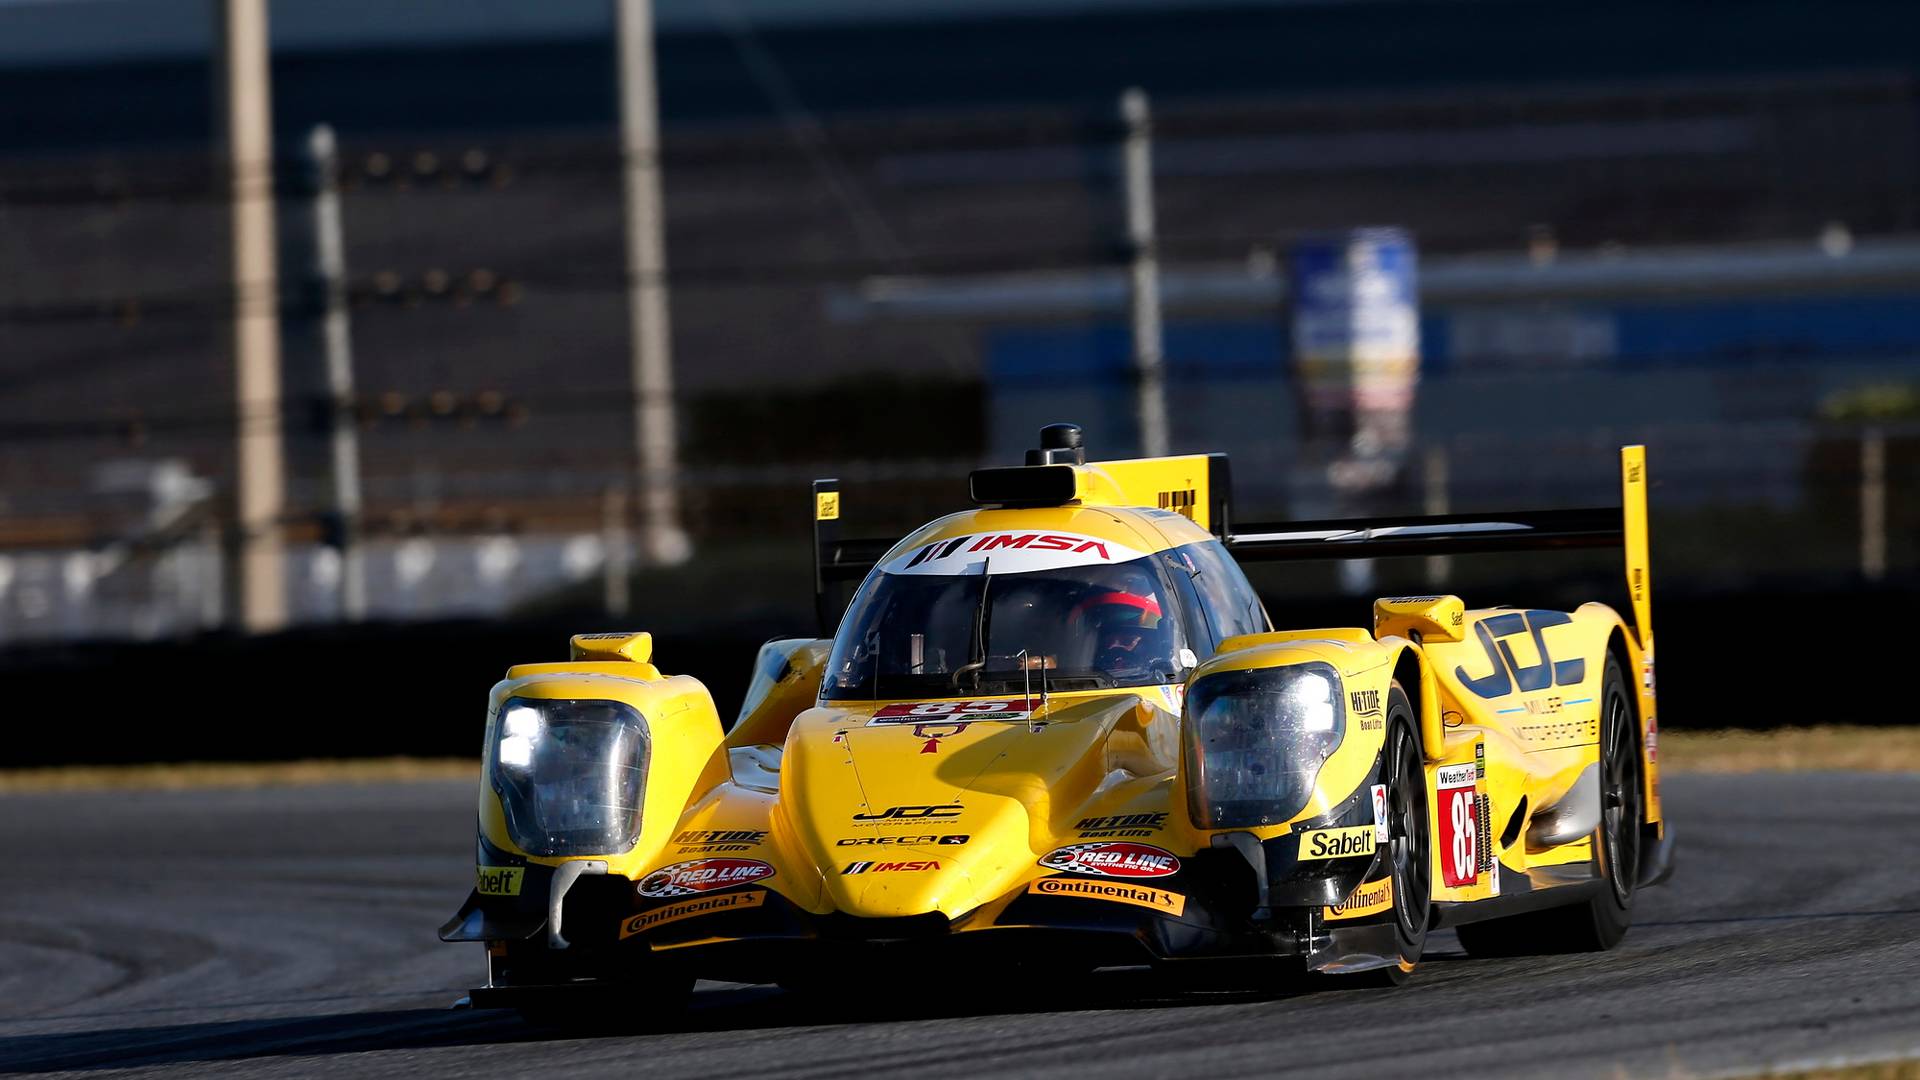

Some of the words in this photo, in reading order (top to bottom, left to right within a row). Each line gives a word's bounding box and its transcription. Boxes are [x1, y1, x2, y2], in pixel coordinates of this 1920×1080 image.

[967, 534, 1111, 560] IMSA
[1455, 610, 1585, 699] JDC
[909, 700, 1009, 715] 85
[852, 805, 965, 820] JDC
[836, 836, 938, 846] ORECA
[1310, 829, 1371, 857] Sabelt
[1451, 791, 1476, 880] 85
[872, 861, 941, 872] IMSA
[1079, 851, 1124, 864] RED
[1126, 852, 1173, 871] LINE
[1090, 862, 1138, 871] SYNTHETIC
[674, 868, 717, 884] RED
[717, 866, 767, 879] LINE
[1036, 879, 1155, 903] Continental
[626, 895, 738, 933] Continental
